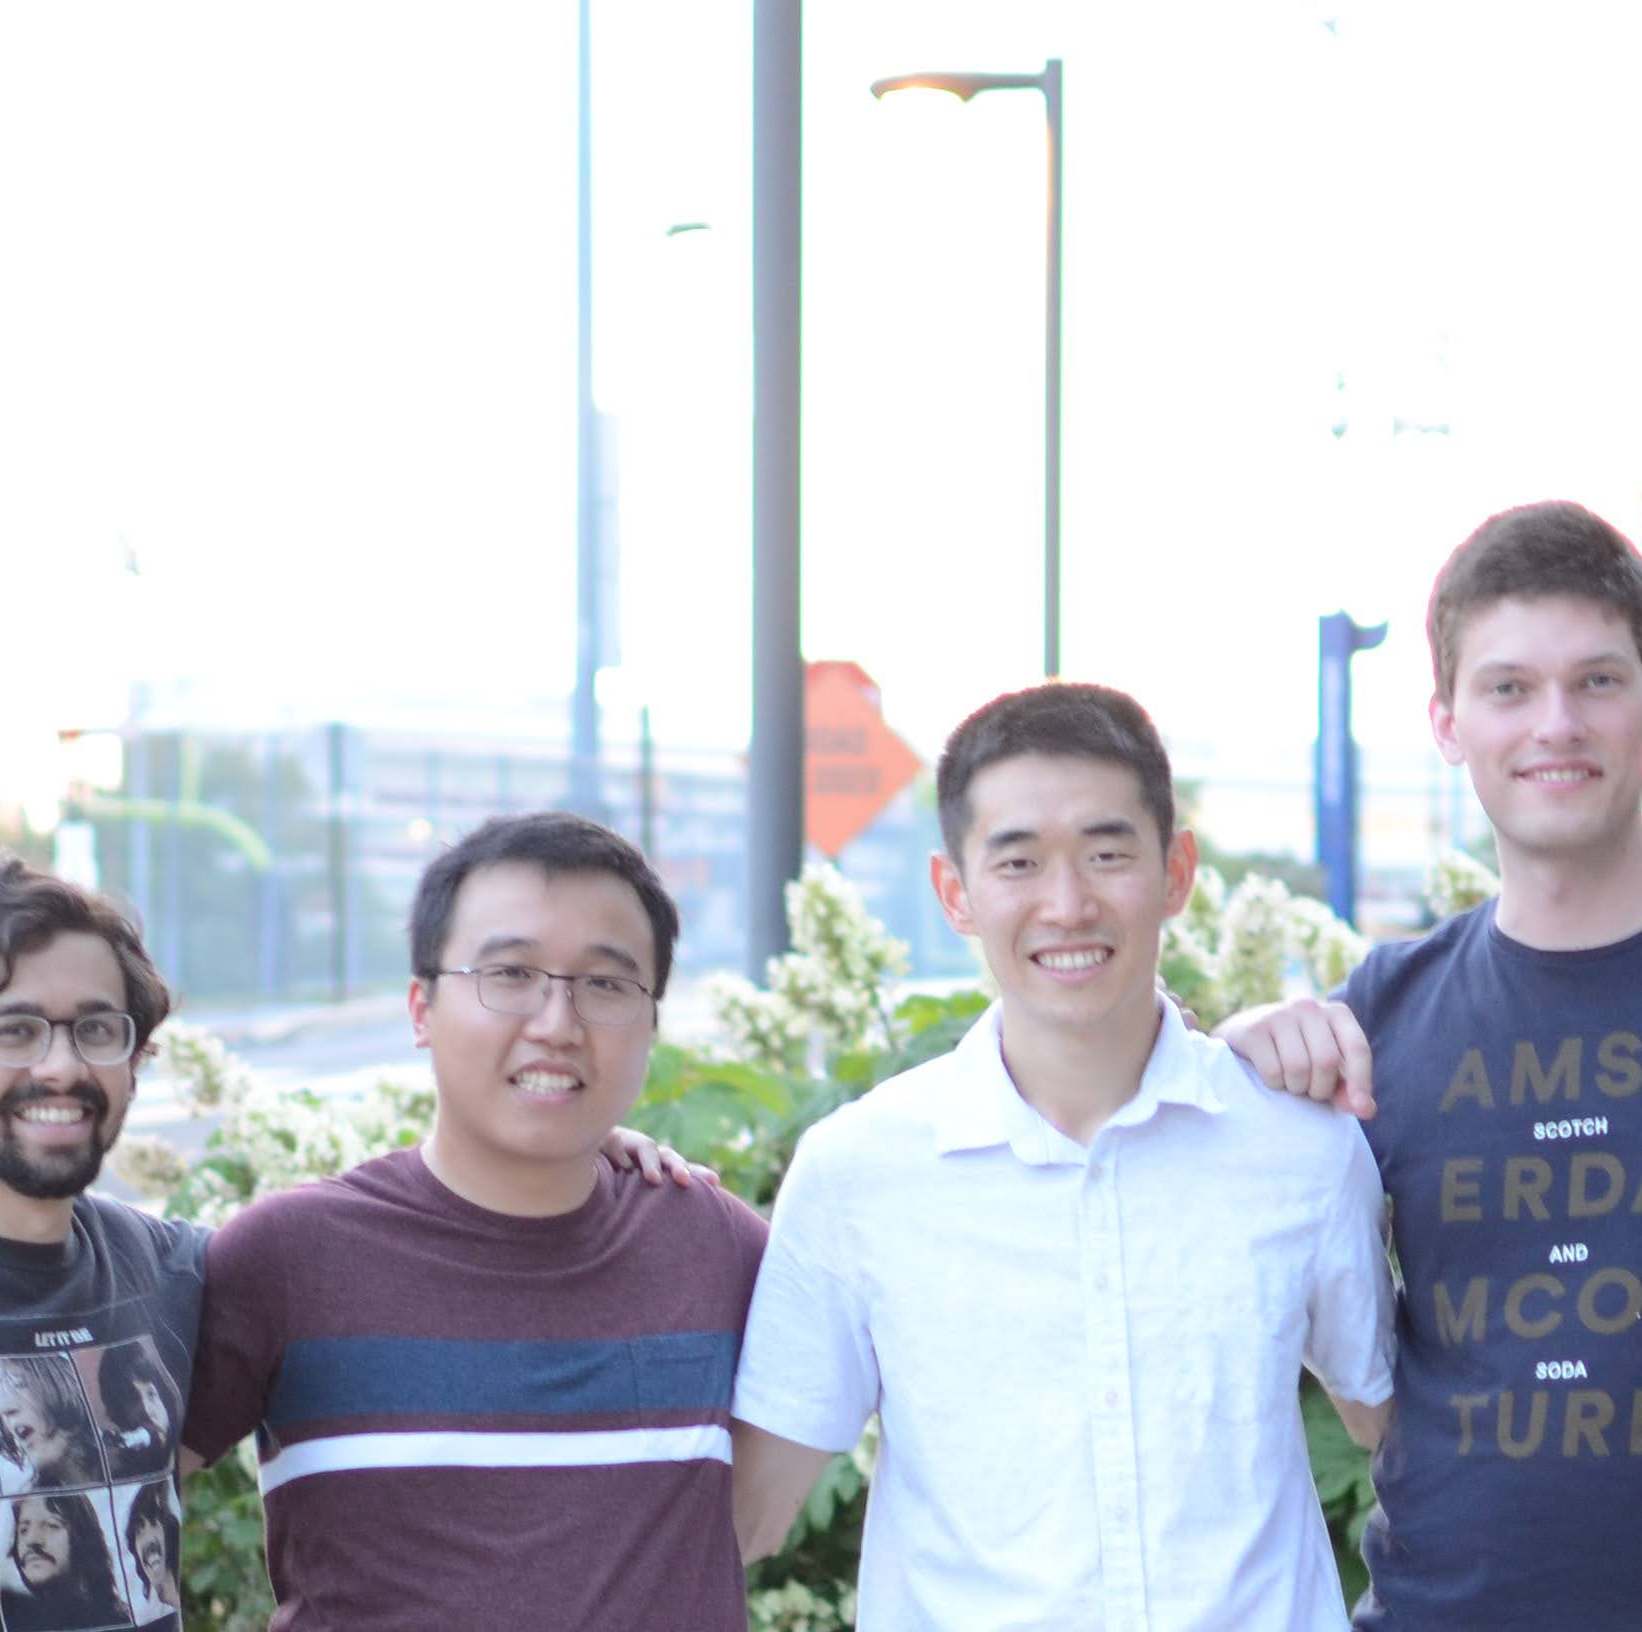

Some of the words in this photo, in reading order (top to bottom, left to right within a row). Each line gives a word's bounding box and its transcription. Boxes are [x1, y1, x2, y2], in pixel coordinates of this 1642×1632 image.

[1533, 1116, 1608, 1140] SCOTCH
[1549, 1243, 1589, 1264] AND
[1535, 1360, 1588, 1380] SODA
